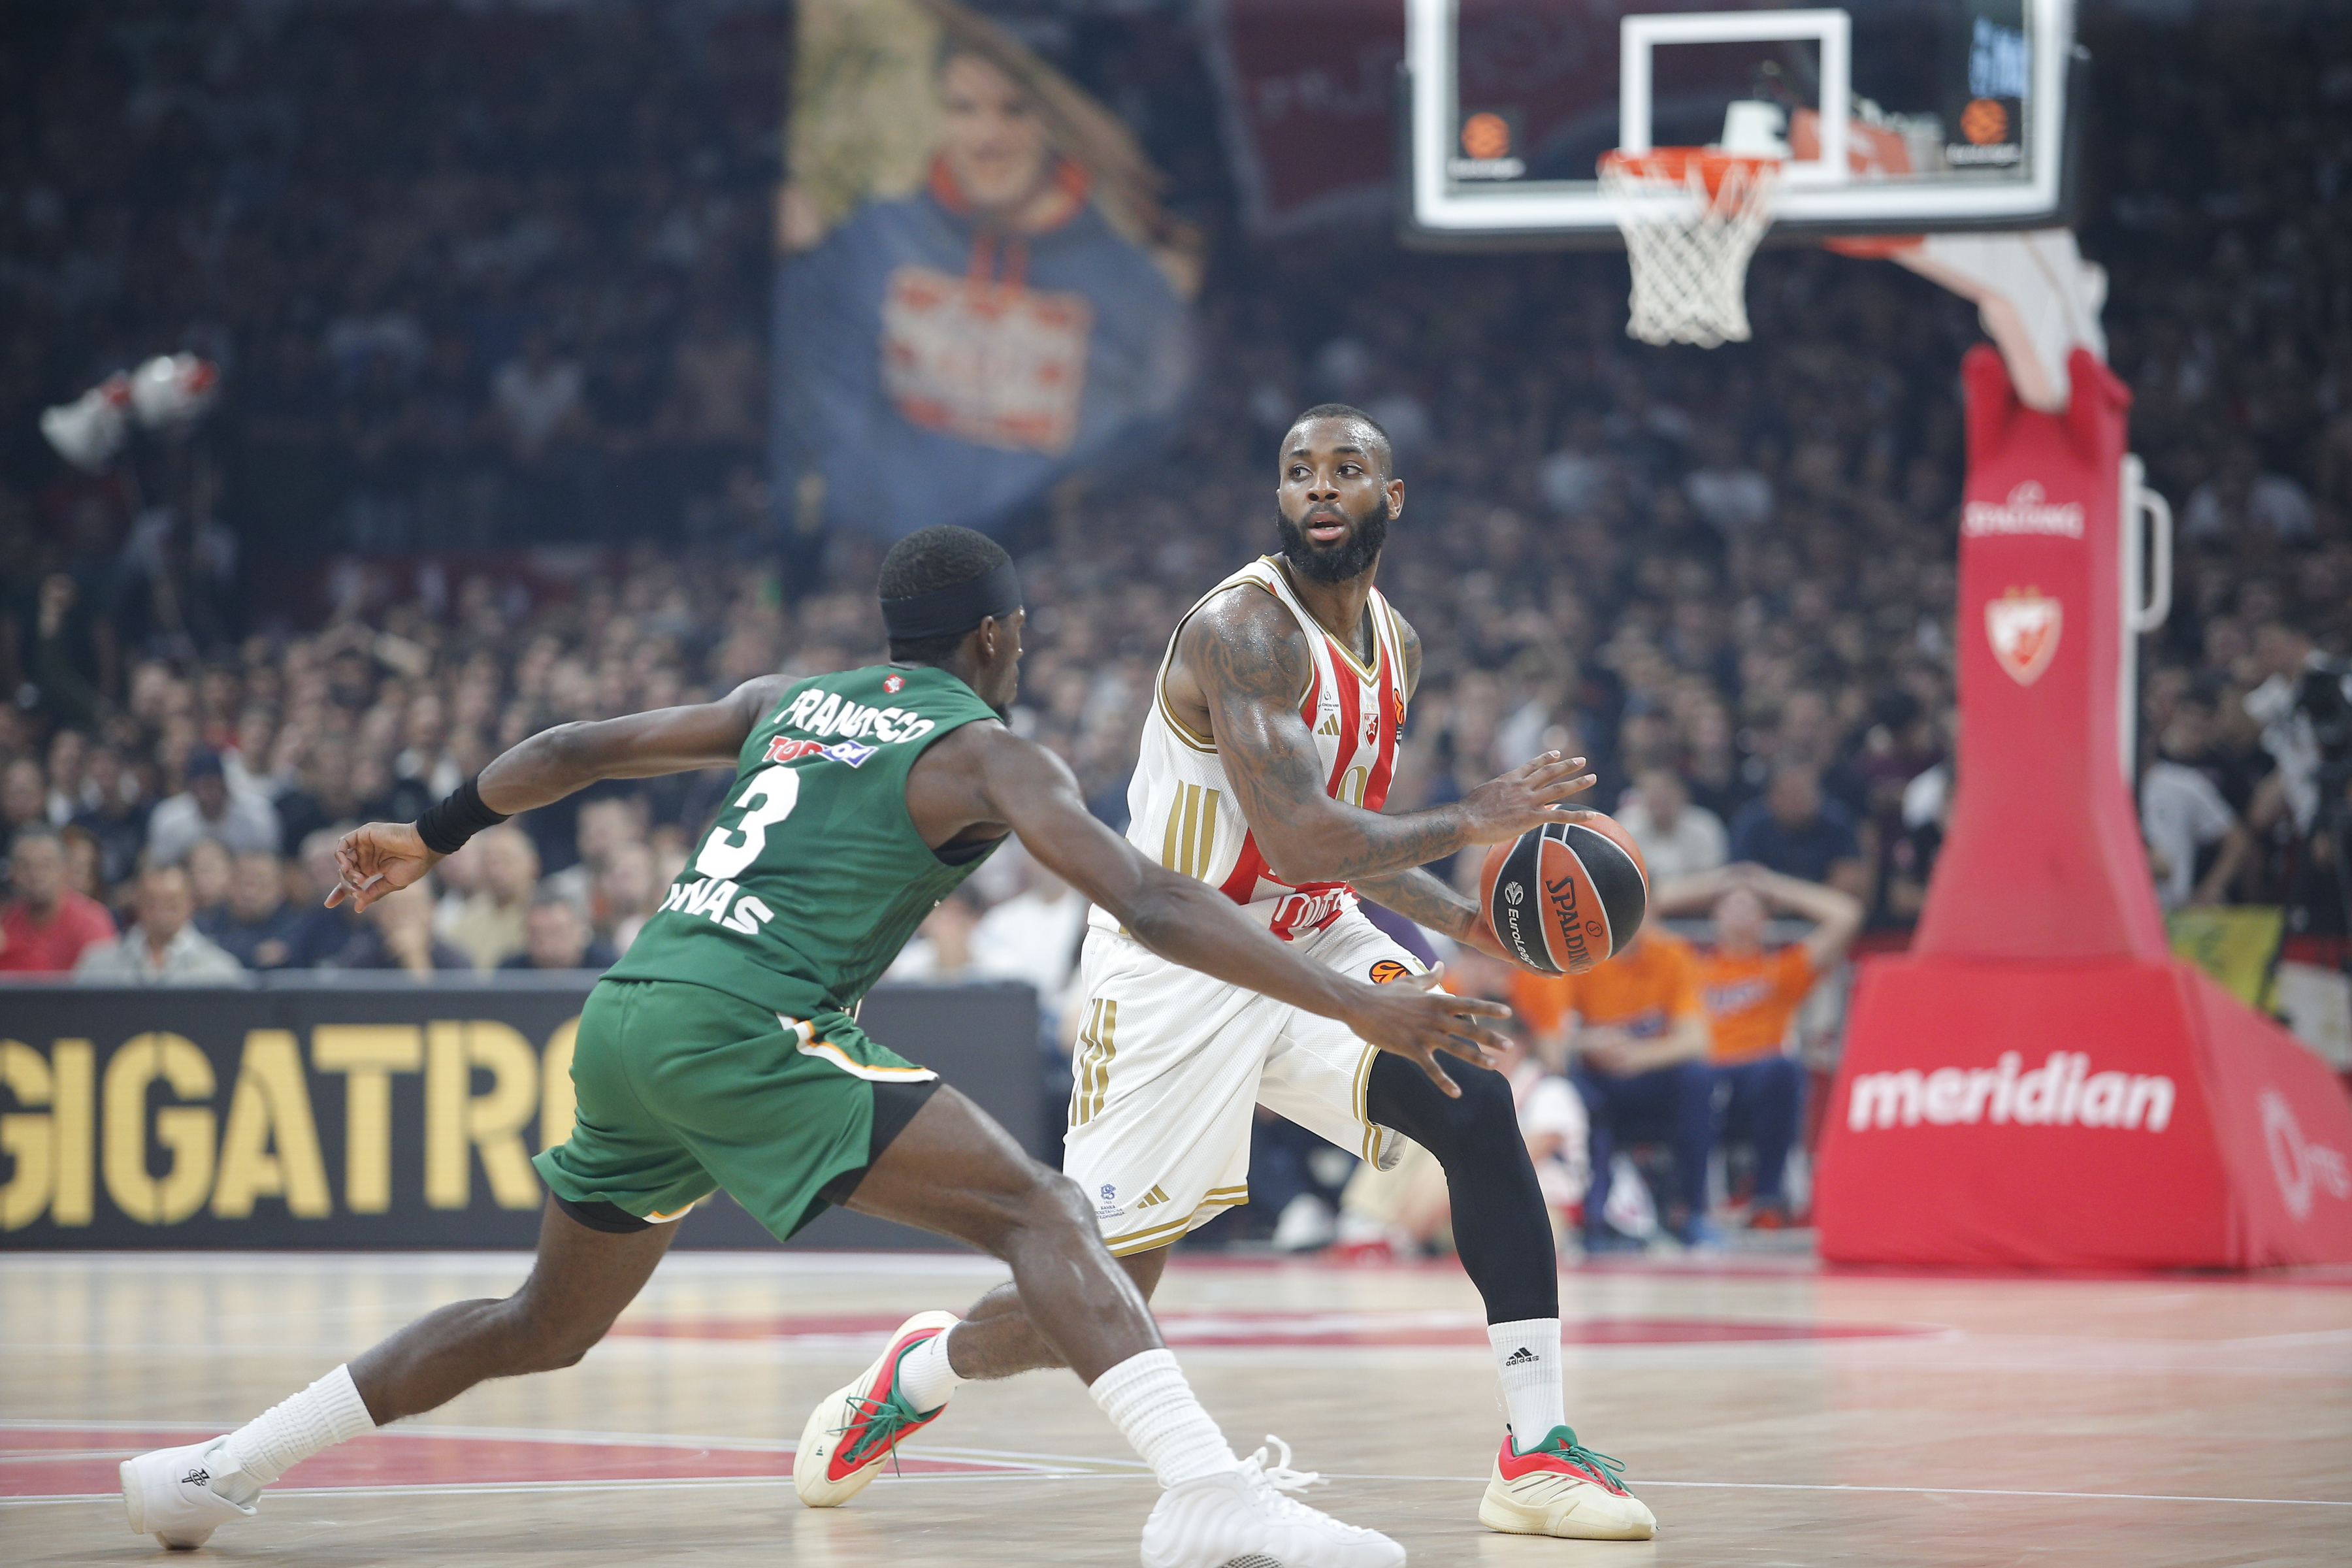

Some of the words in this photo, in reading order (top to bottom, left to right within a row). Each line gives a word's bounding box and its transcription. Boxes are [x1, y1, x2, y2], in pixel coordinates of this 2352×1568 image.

[695, 764, 801, 879] 3
[1848, 1049, 2176, 1134] meridian
[1506, 1355, 1539, 1366] adidas
